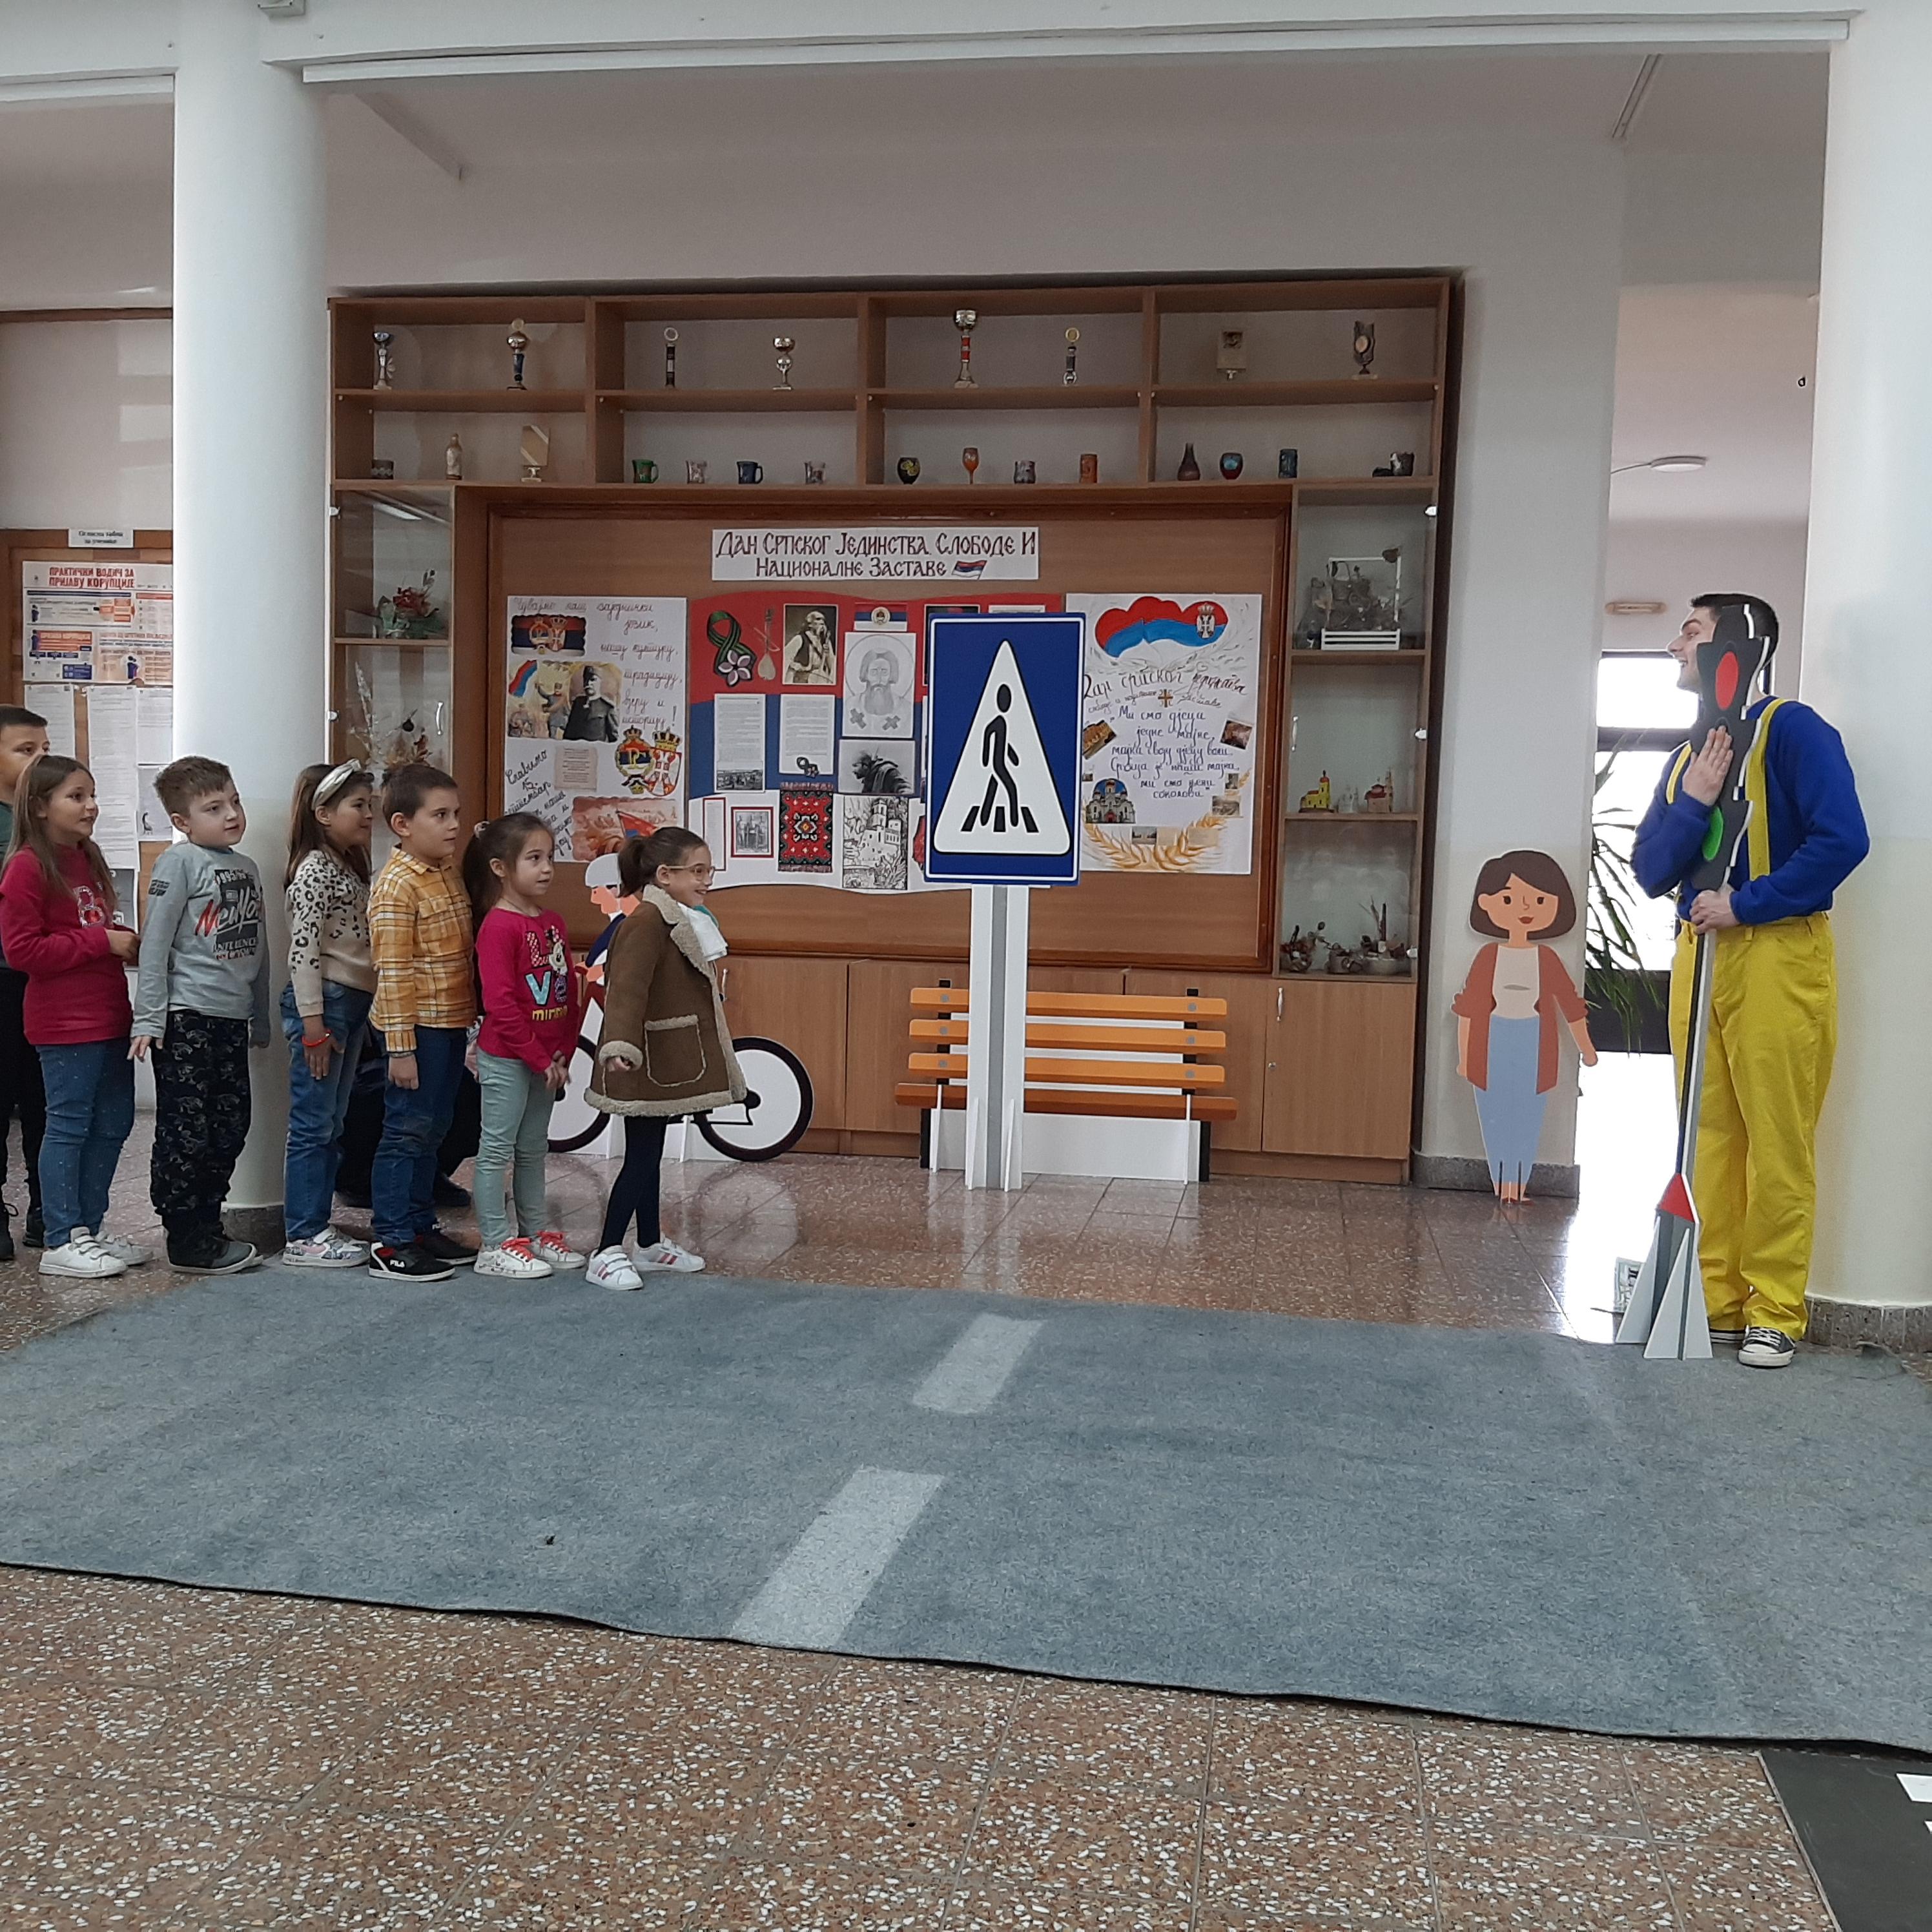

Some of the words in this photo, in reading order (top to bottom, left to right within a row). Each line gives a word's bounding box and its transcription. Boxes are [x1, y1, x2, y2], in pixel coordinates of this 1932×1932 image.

[49, 567, 94, 576] ПРАКТИЧНИ
[96, 568, 123, 577] ВОДИЧ
[48, 577, 84, 588] ПРИЈАВУ
[87, 578, 135, 590] КОРУПЦИЈЕ
[1140, 712, 1163, 721] смо
[389, 1259, 405, 1268] FILA
